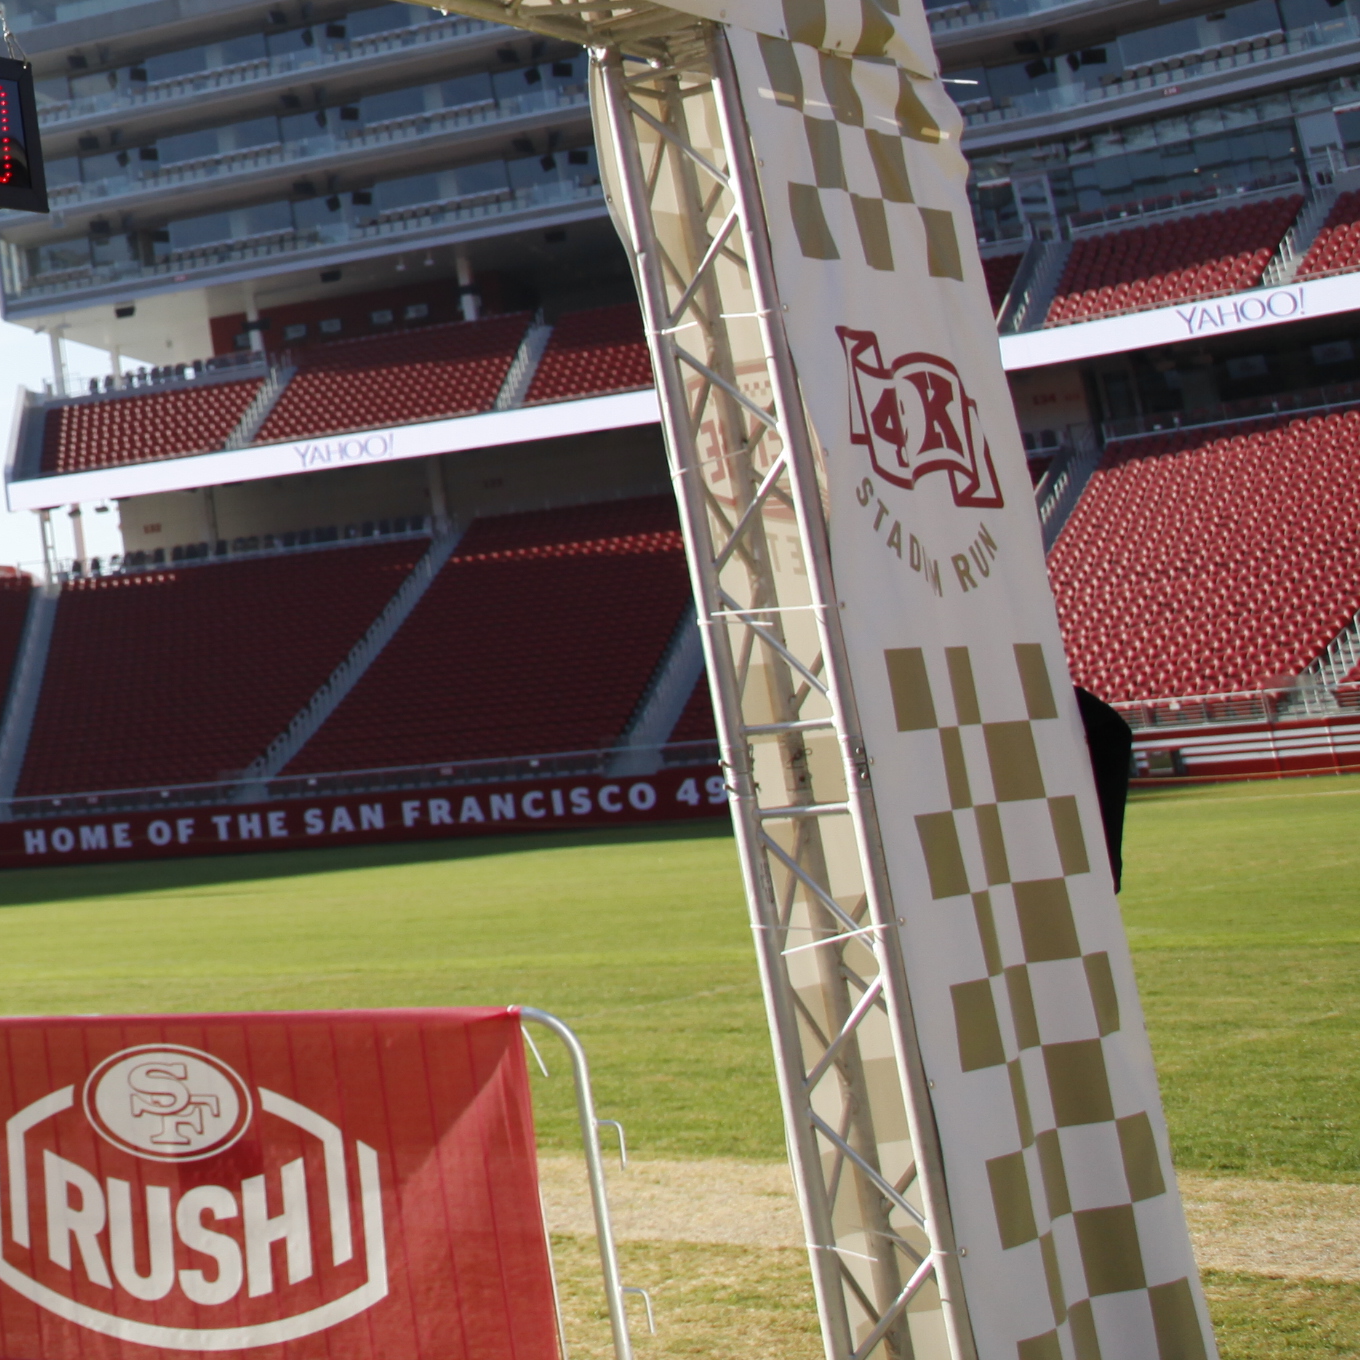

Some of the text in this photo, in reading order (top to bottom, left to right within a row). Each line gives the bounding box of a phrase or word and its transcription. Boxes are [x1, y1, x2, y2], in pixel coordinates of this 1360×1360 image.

[1176, 286, 1305, 335] YAHOO!
[294, 433, 394, 468] YAHOO!
[950, 521, 998, 593] RUN
[23, 822, 133, 854] HOME
[147, 818, 196, 846] OF
[211, 810, 289, 841] THE
[303, 802, 385, 835] SAN
[401, 782, 657, 828] FRANCISCO
[43, 1146, 308, 1307] RUSH
